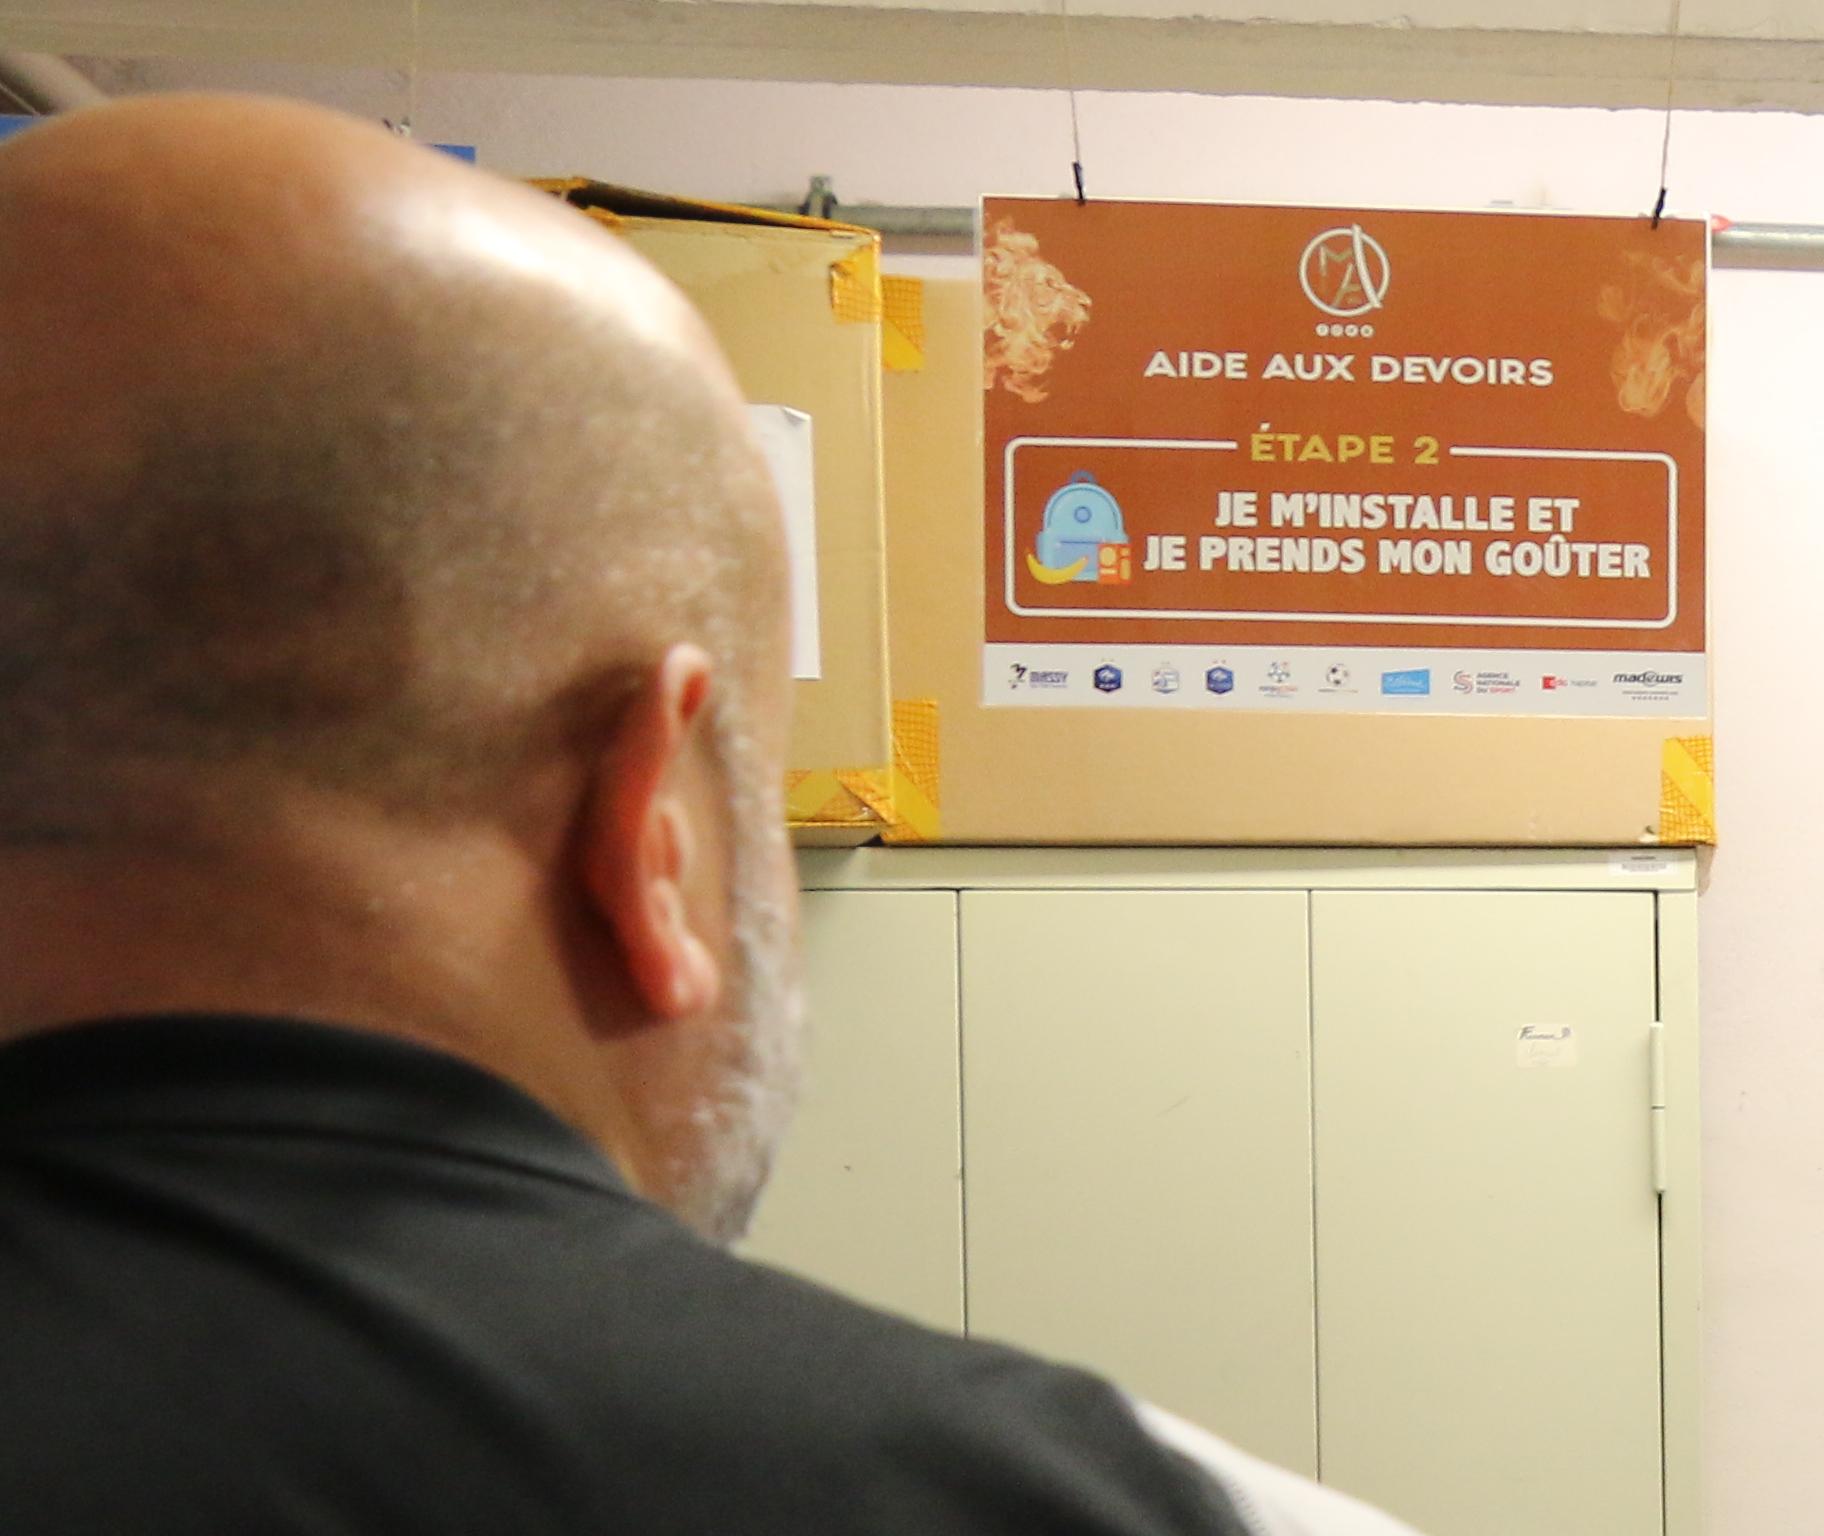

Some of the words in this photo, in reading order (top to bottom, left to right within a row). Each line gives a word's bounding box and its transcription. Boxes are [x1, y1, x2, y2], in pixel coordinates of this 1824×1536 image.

[1144, 352, 1247, 378] AIDE
[1262, 354, 1354, 380] AUX
[1372, 356, 1553, 386] DEVOIRS
[1251, 423, 1394, 463] ÉTAPE
[1414, 436, 1438, 464] 2
[1216, 492, 1257, 526] JE
[1529, 498, 1579, 532] ET
[1144, 536, 1186, 570] JE
[1200, 537, 1365, 573] PRENDS
[1379, 540, 1471, 574] MON
[1485, 534, 1650, 577] GOÛTER
